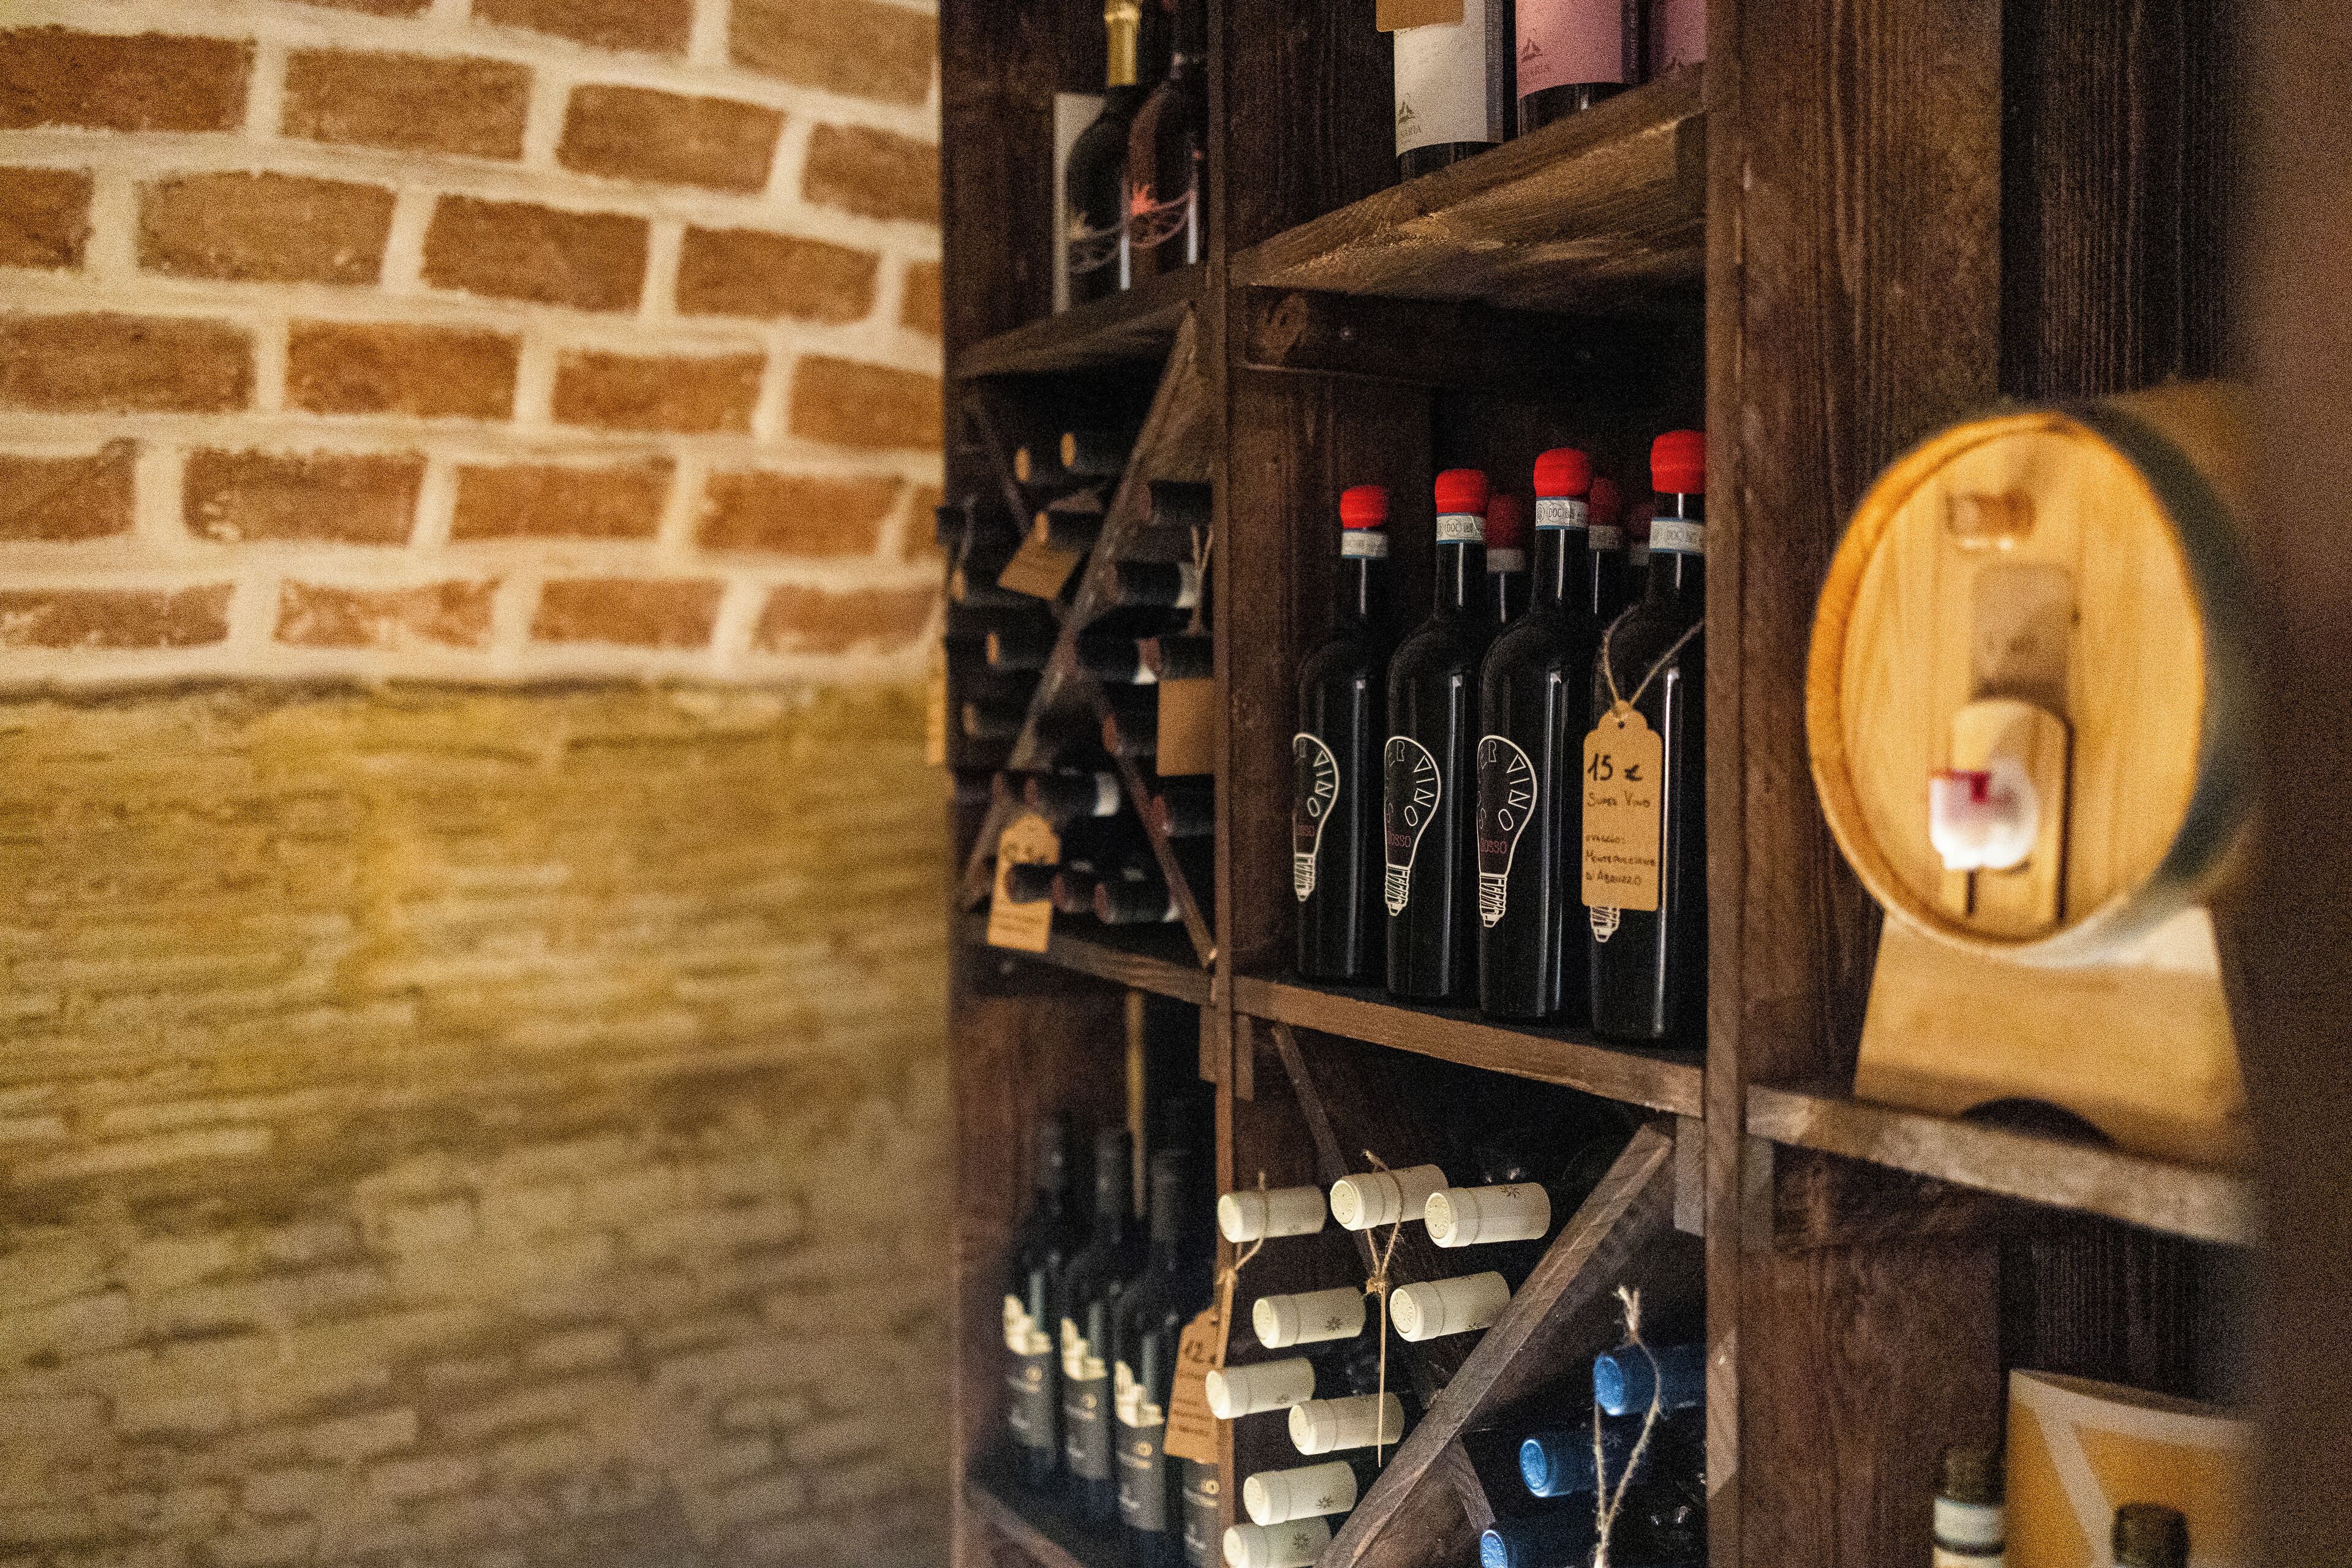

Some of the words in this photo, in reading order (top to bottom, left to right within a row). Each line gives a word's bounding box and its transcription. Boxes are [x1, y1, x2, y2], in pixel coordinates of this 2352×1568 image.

[1306, 750, 1333, 818] VINO
[1404, 755, 1435, 827] VINO
[1498, 753, 1531, 831] VINO
[1587, 752, 1613, 782] 15
